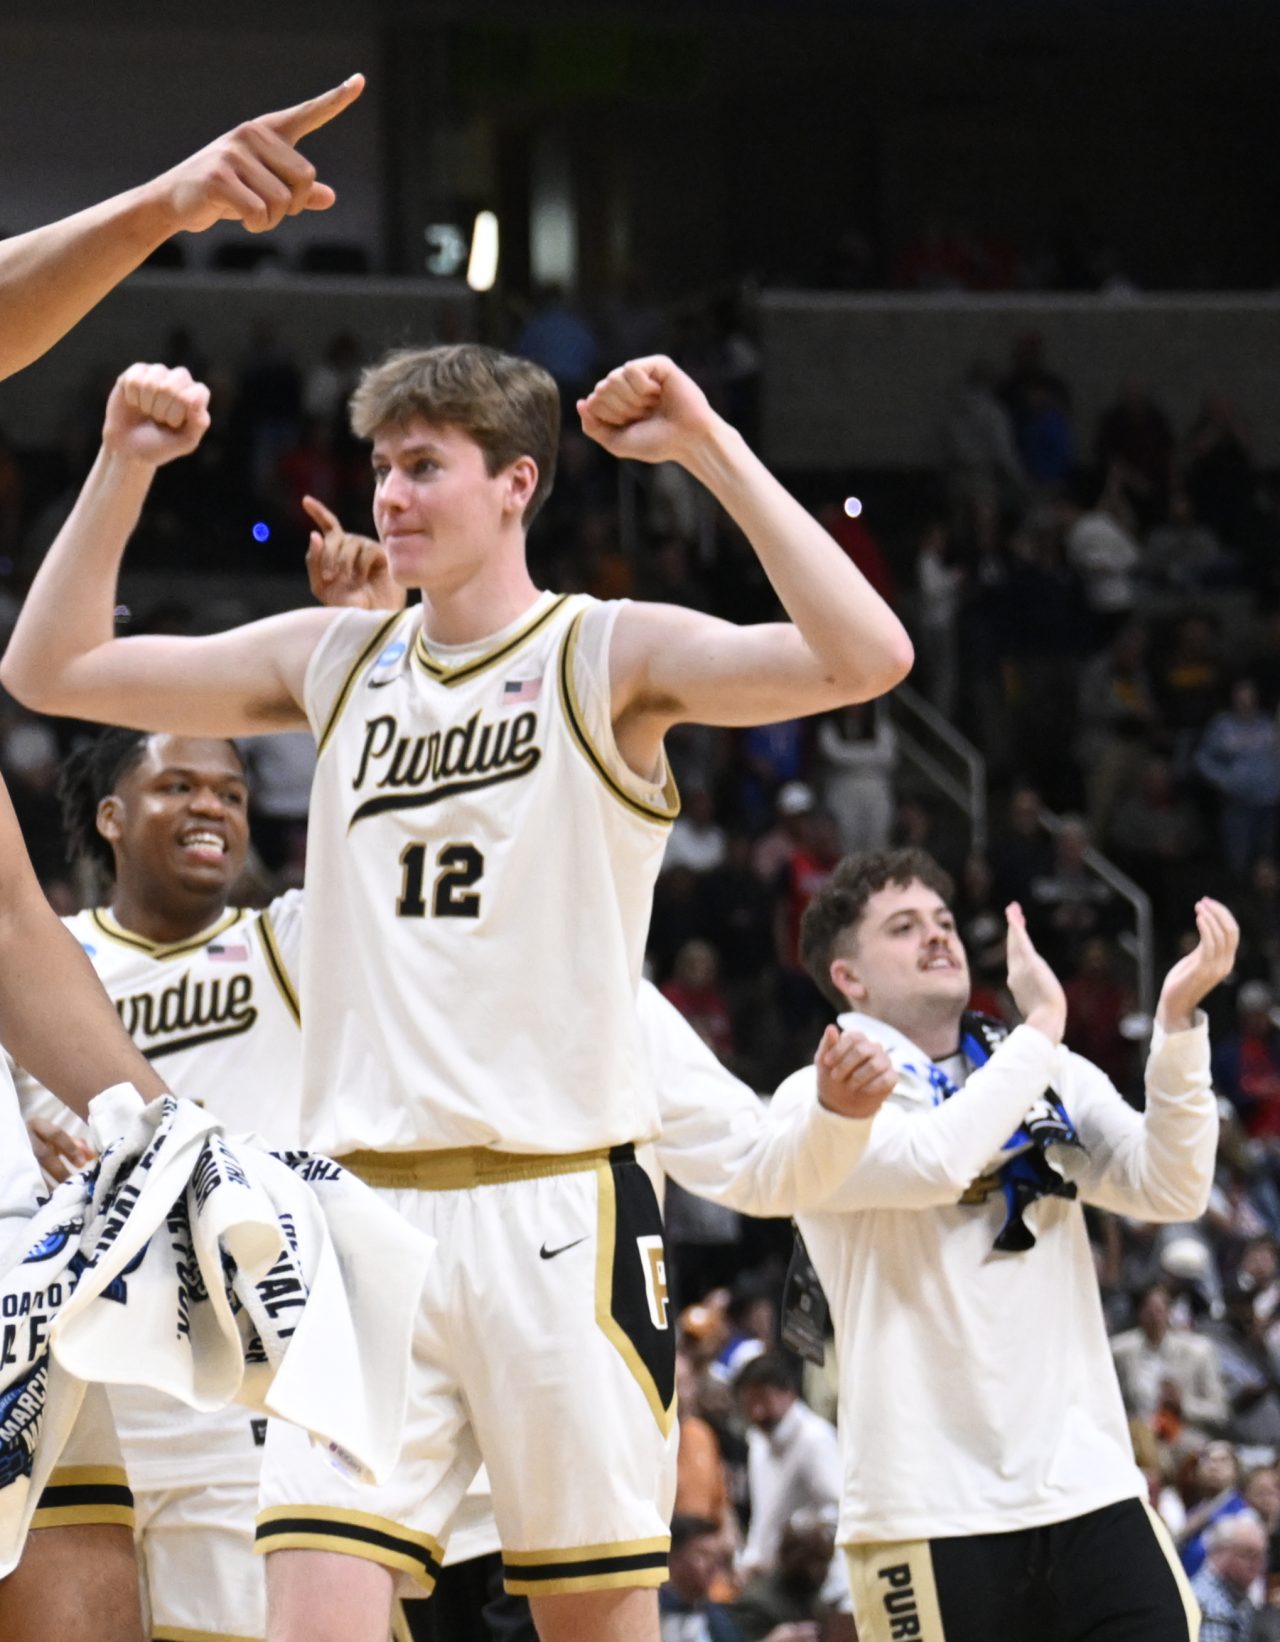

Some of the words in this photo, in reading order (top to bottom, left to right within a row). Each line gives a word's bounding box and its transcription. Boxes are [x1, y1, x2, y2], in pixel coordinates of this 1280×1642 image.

[348, 707, 543, 818] Purdue
[395, 840, 485, 919] 12
[116, 968, 258, 1043] urdue
[877, 1561, 924, 1642] PUR
